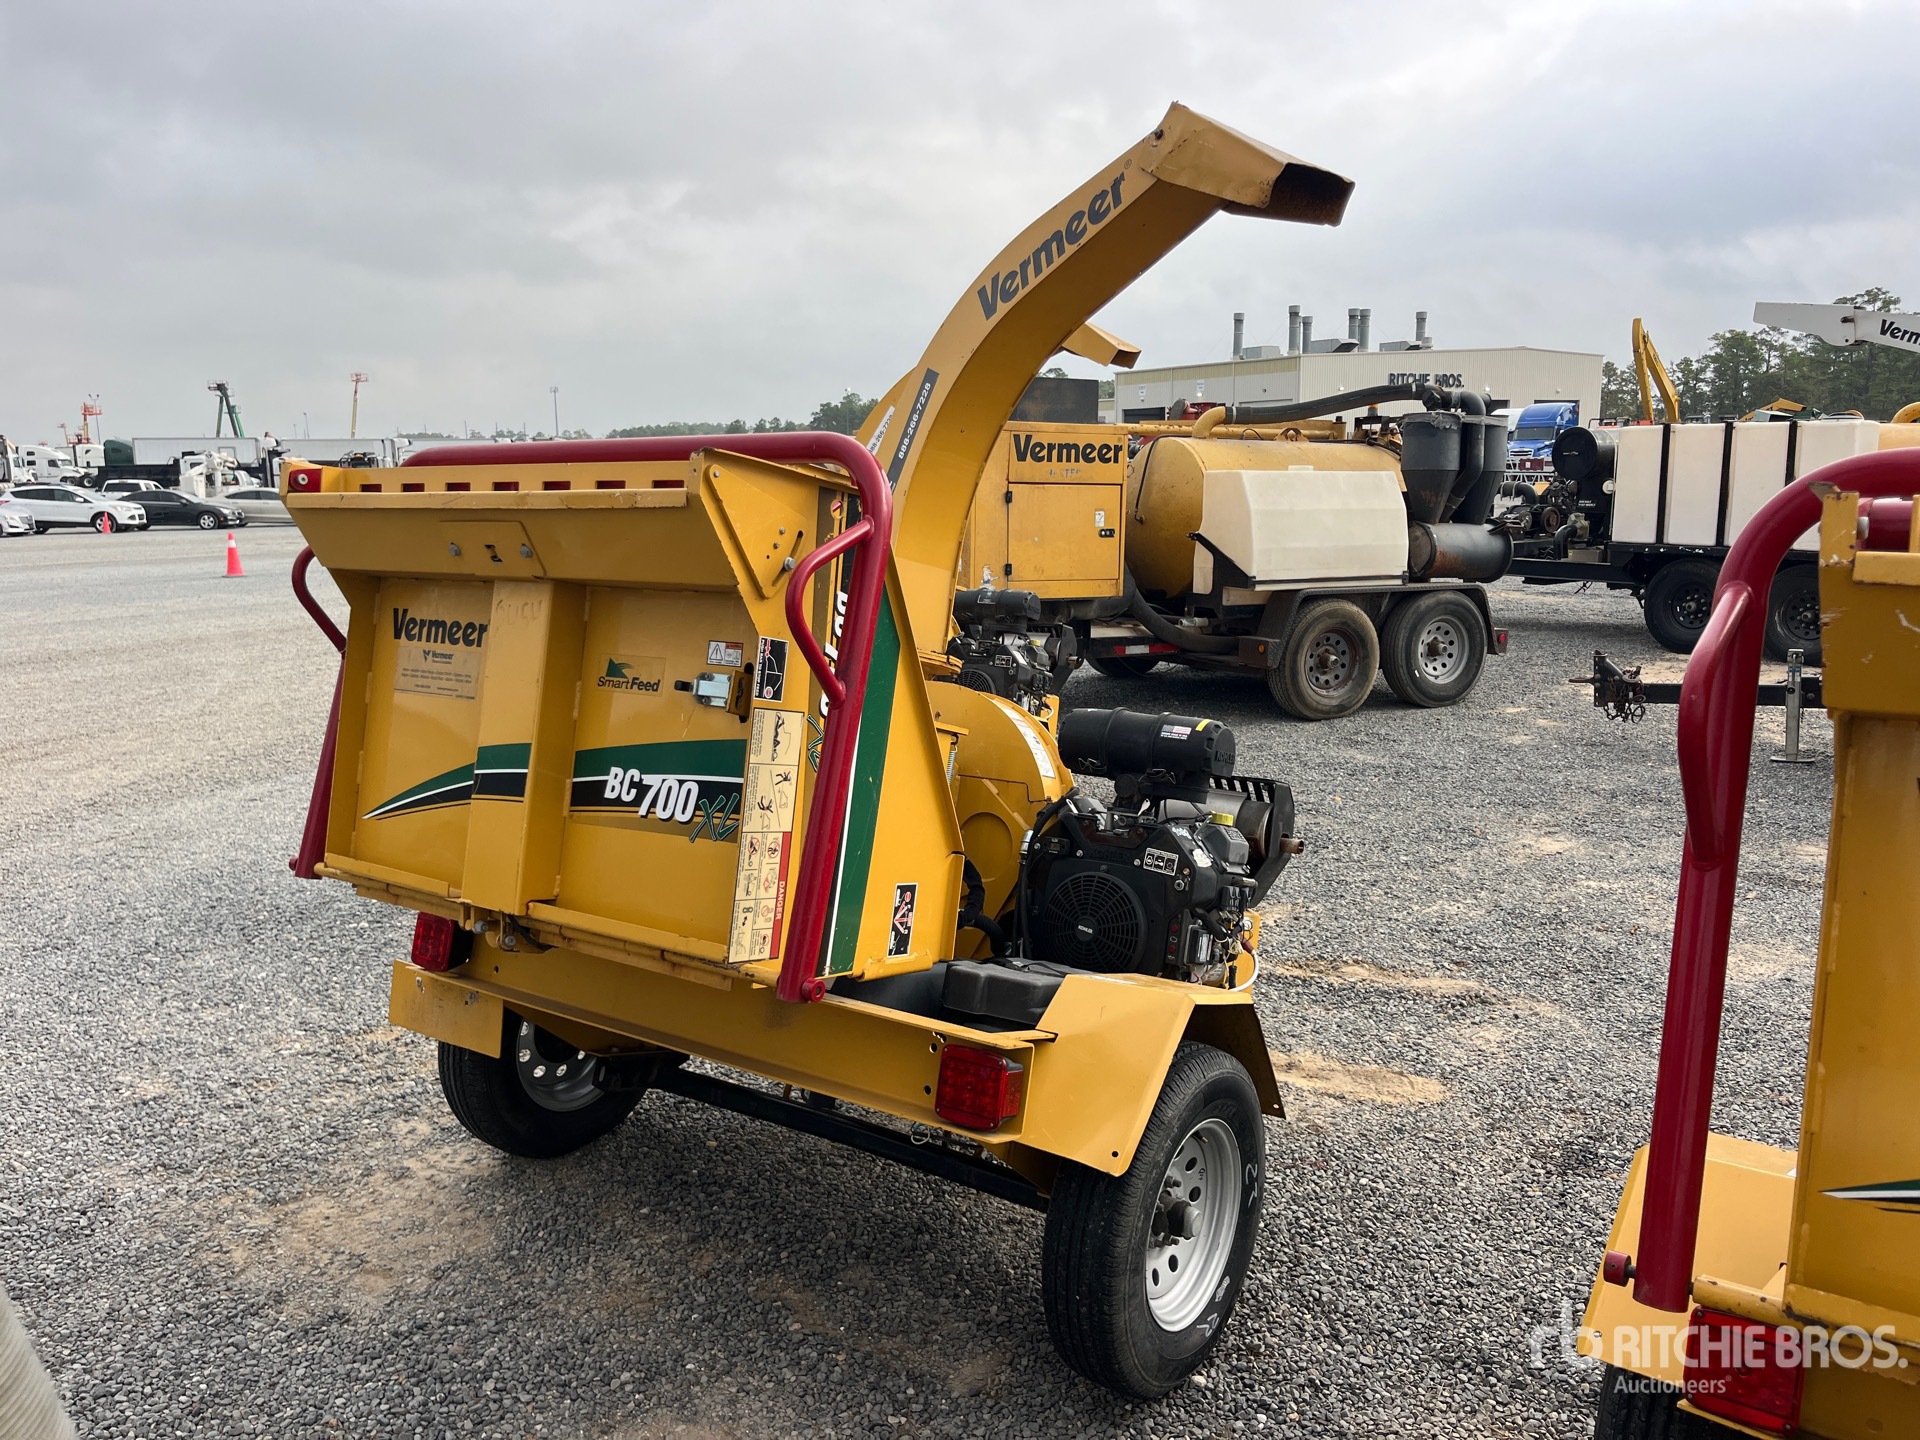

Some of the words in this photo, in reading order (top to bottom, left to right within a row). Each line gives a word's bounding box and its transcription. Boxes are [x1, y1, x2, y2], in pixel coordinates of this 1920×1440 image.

[977, 171, 1125, 321] Vermeer
[1434, 373, 1465, 389] BROS.
[898, 382, 931, 460] 888-266-7228
[1013, 433, 1123, 464] Vermeer
[393, 607, 488, 648] Vermeer
[689, 792, 740, 843] XL
[775, 880, 785, 920] DANGER
